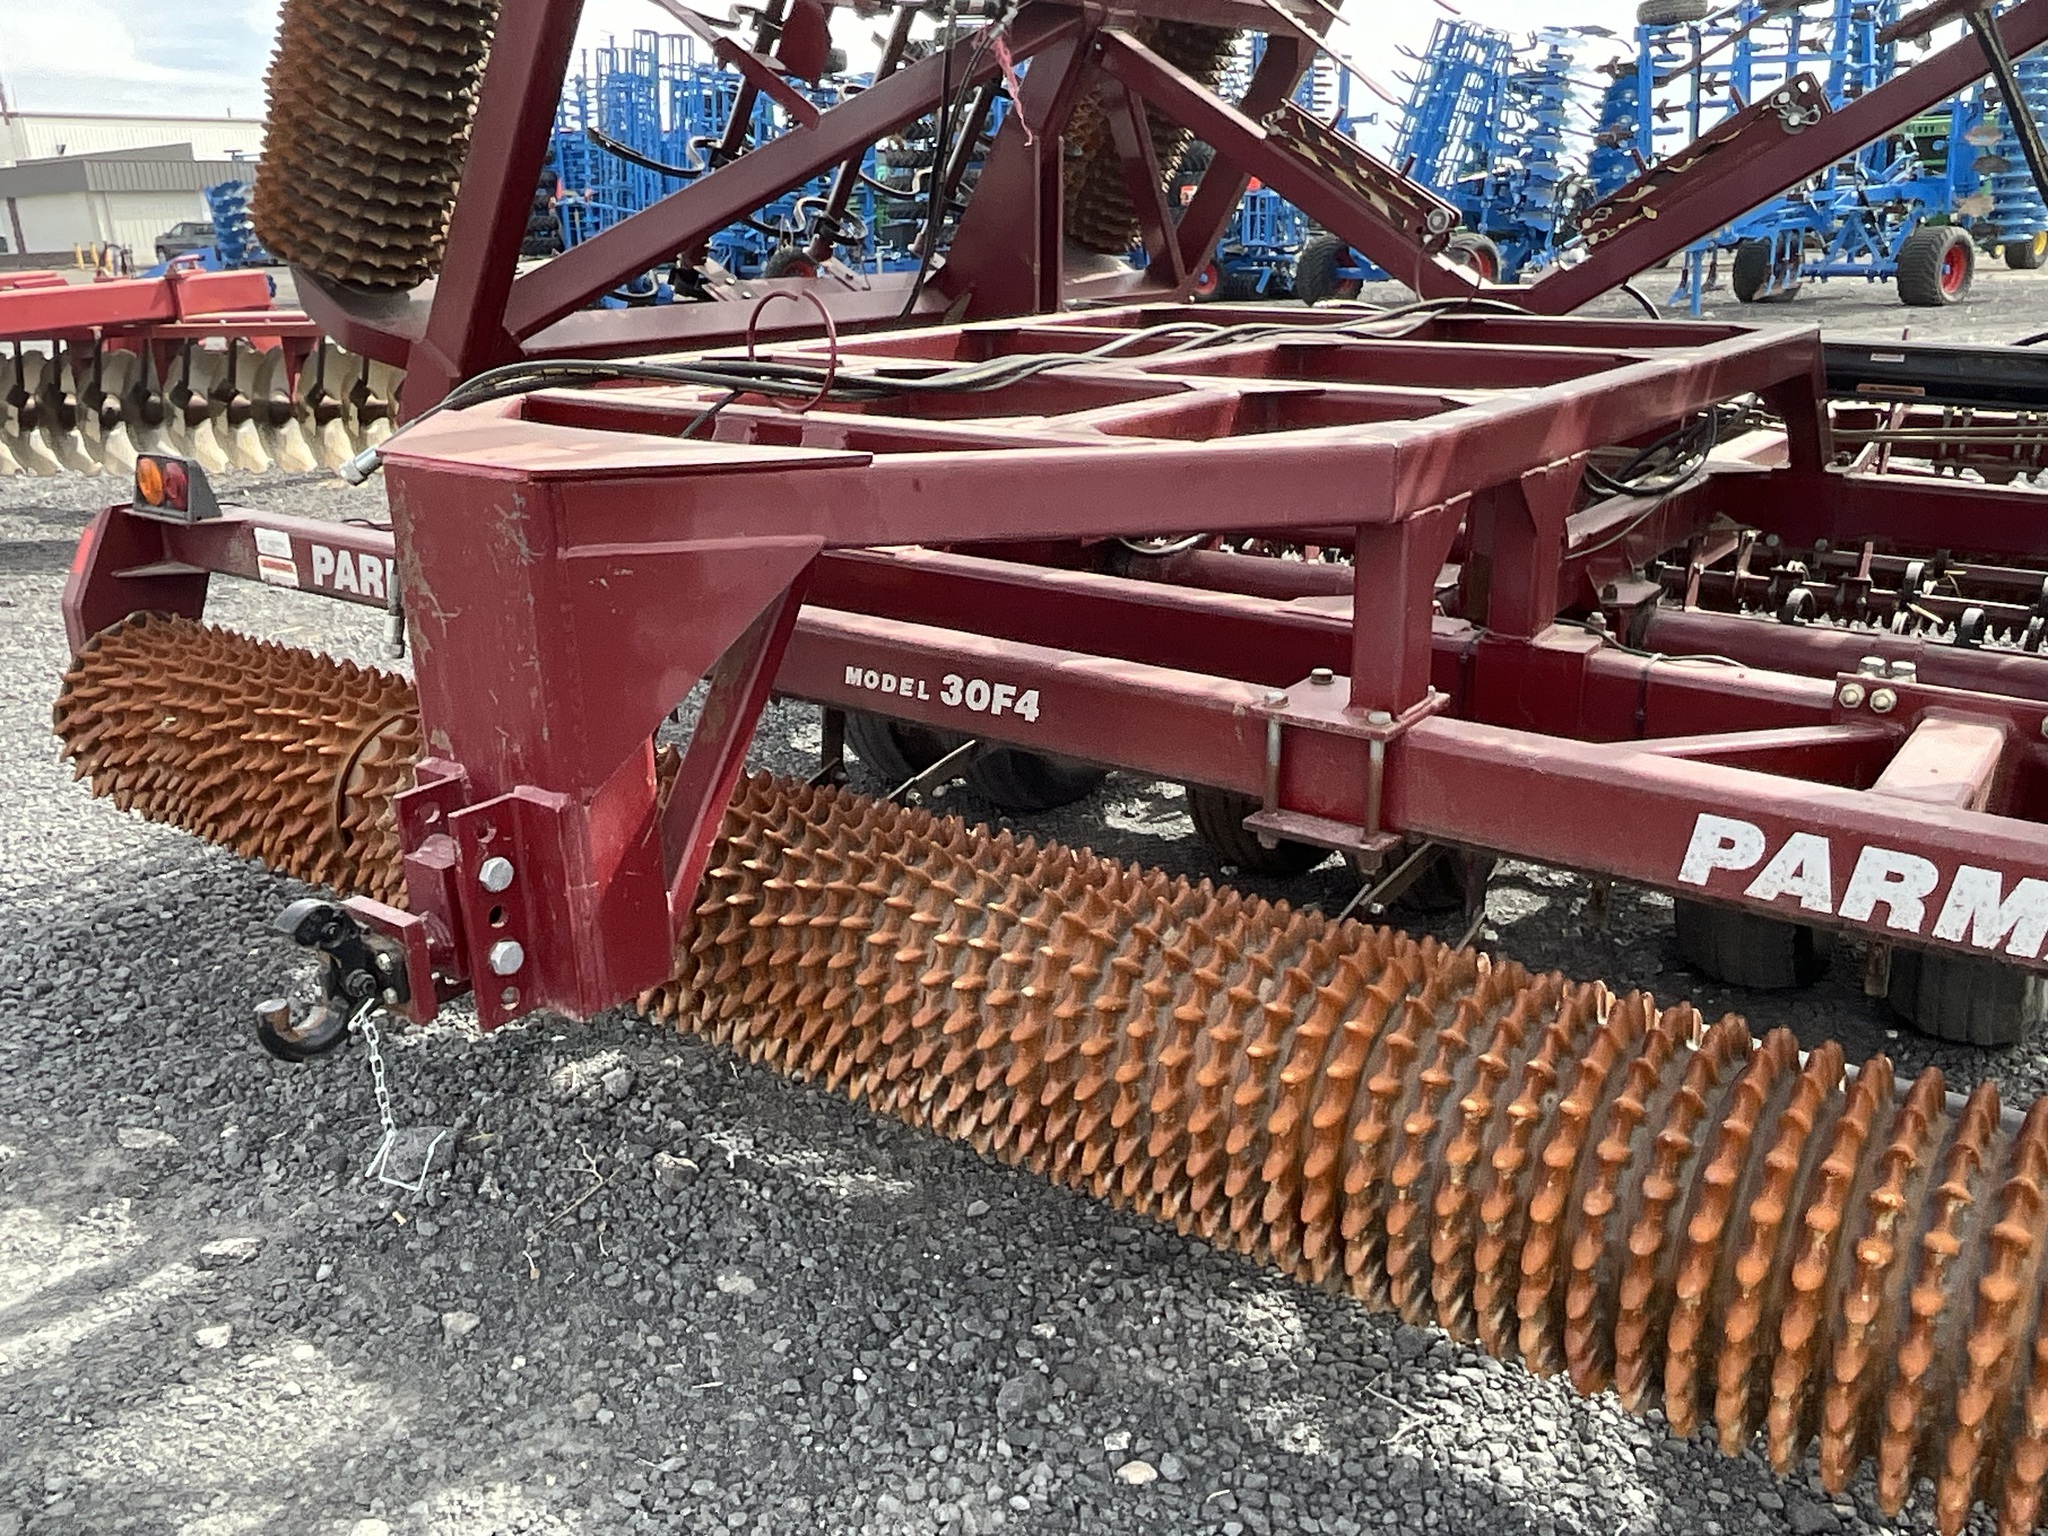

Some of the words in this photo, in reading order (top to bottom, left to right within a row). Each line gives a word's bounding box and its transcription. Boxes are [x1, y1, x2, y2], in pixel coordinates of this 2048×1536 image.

[311, 543, 395, 599] PAR
[844, 665, 930, 701] MODEL
[940, 673, 1041, 723] 30F4
[1677, 812, 2048, 962] PARM
